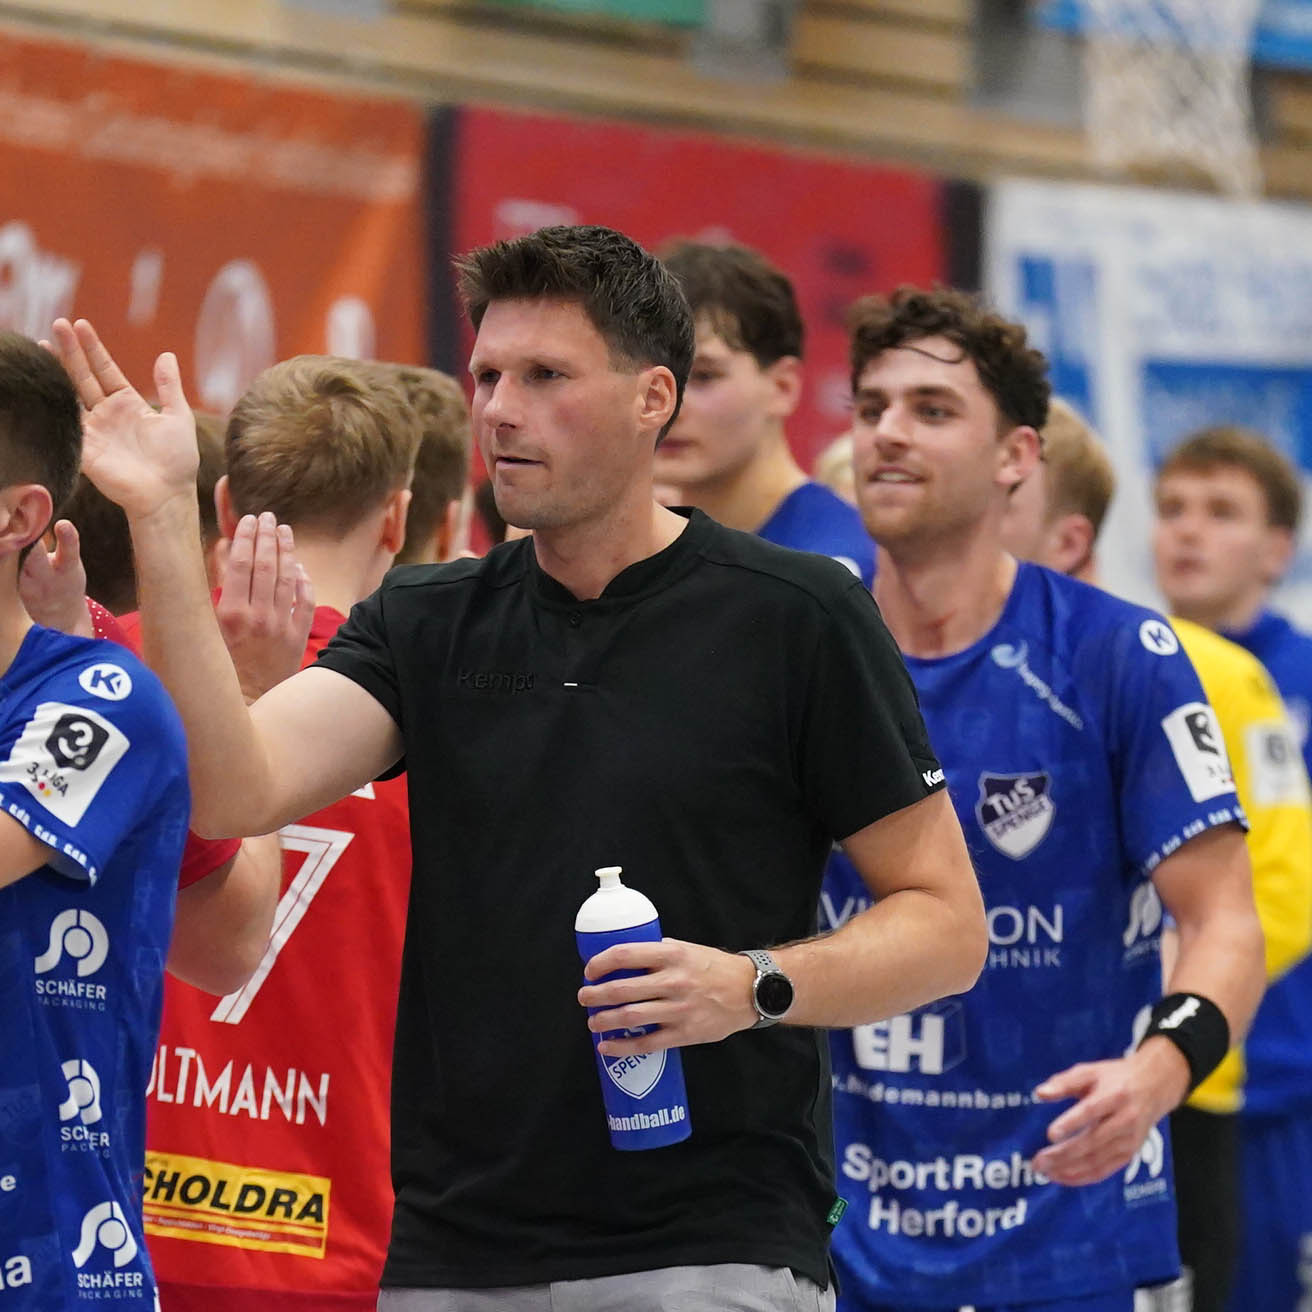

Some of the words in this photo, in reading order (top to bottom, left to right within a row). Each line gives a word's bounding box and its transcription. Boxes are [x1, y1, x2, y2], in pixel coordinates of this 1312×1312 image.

[210, 823, 355, 1025] 7
[35, 979, 107, 1000] SCHÄFER
[868, 1195, 1028, 1238] Herford
[77, 1270, 144, 1289] SCHÄFER
